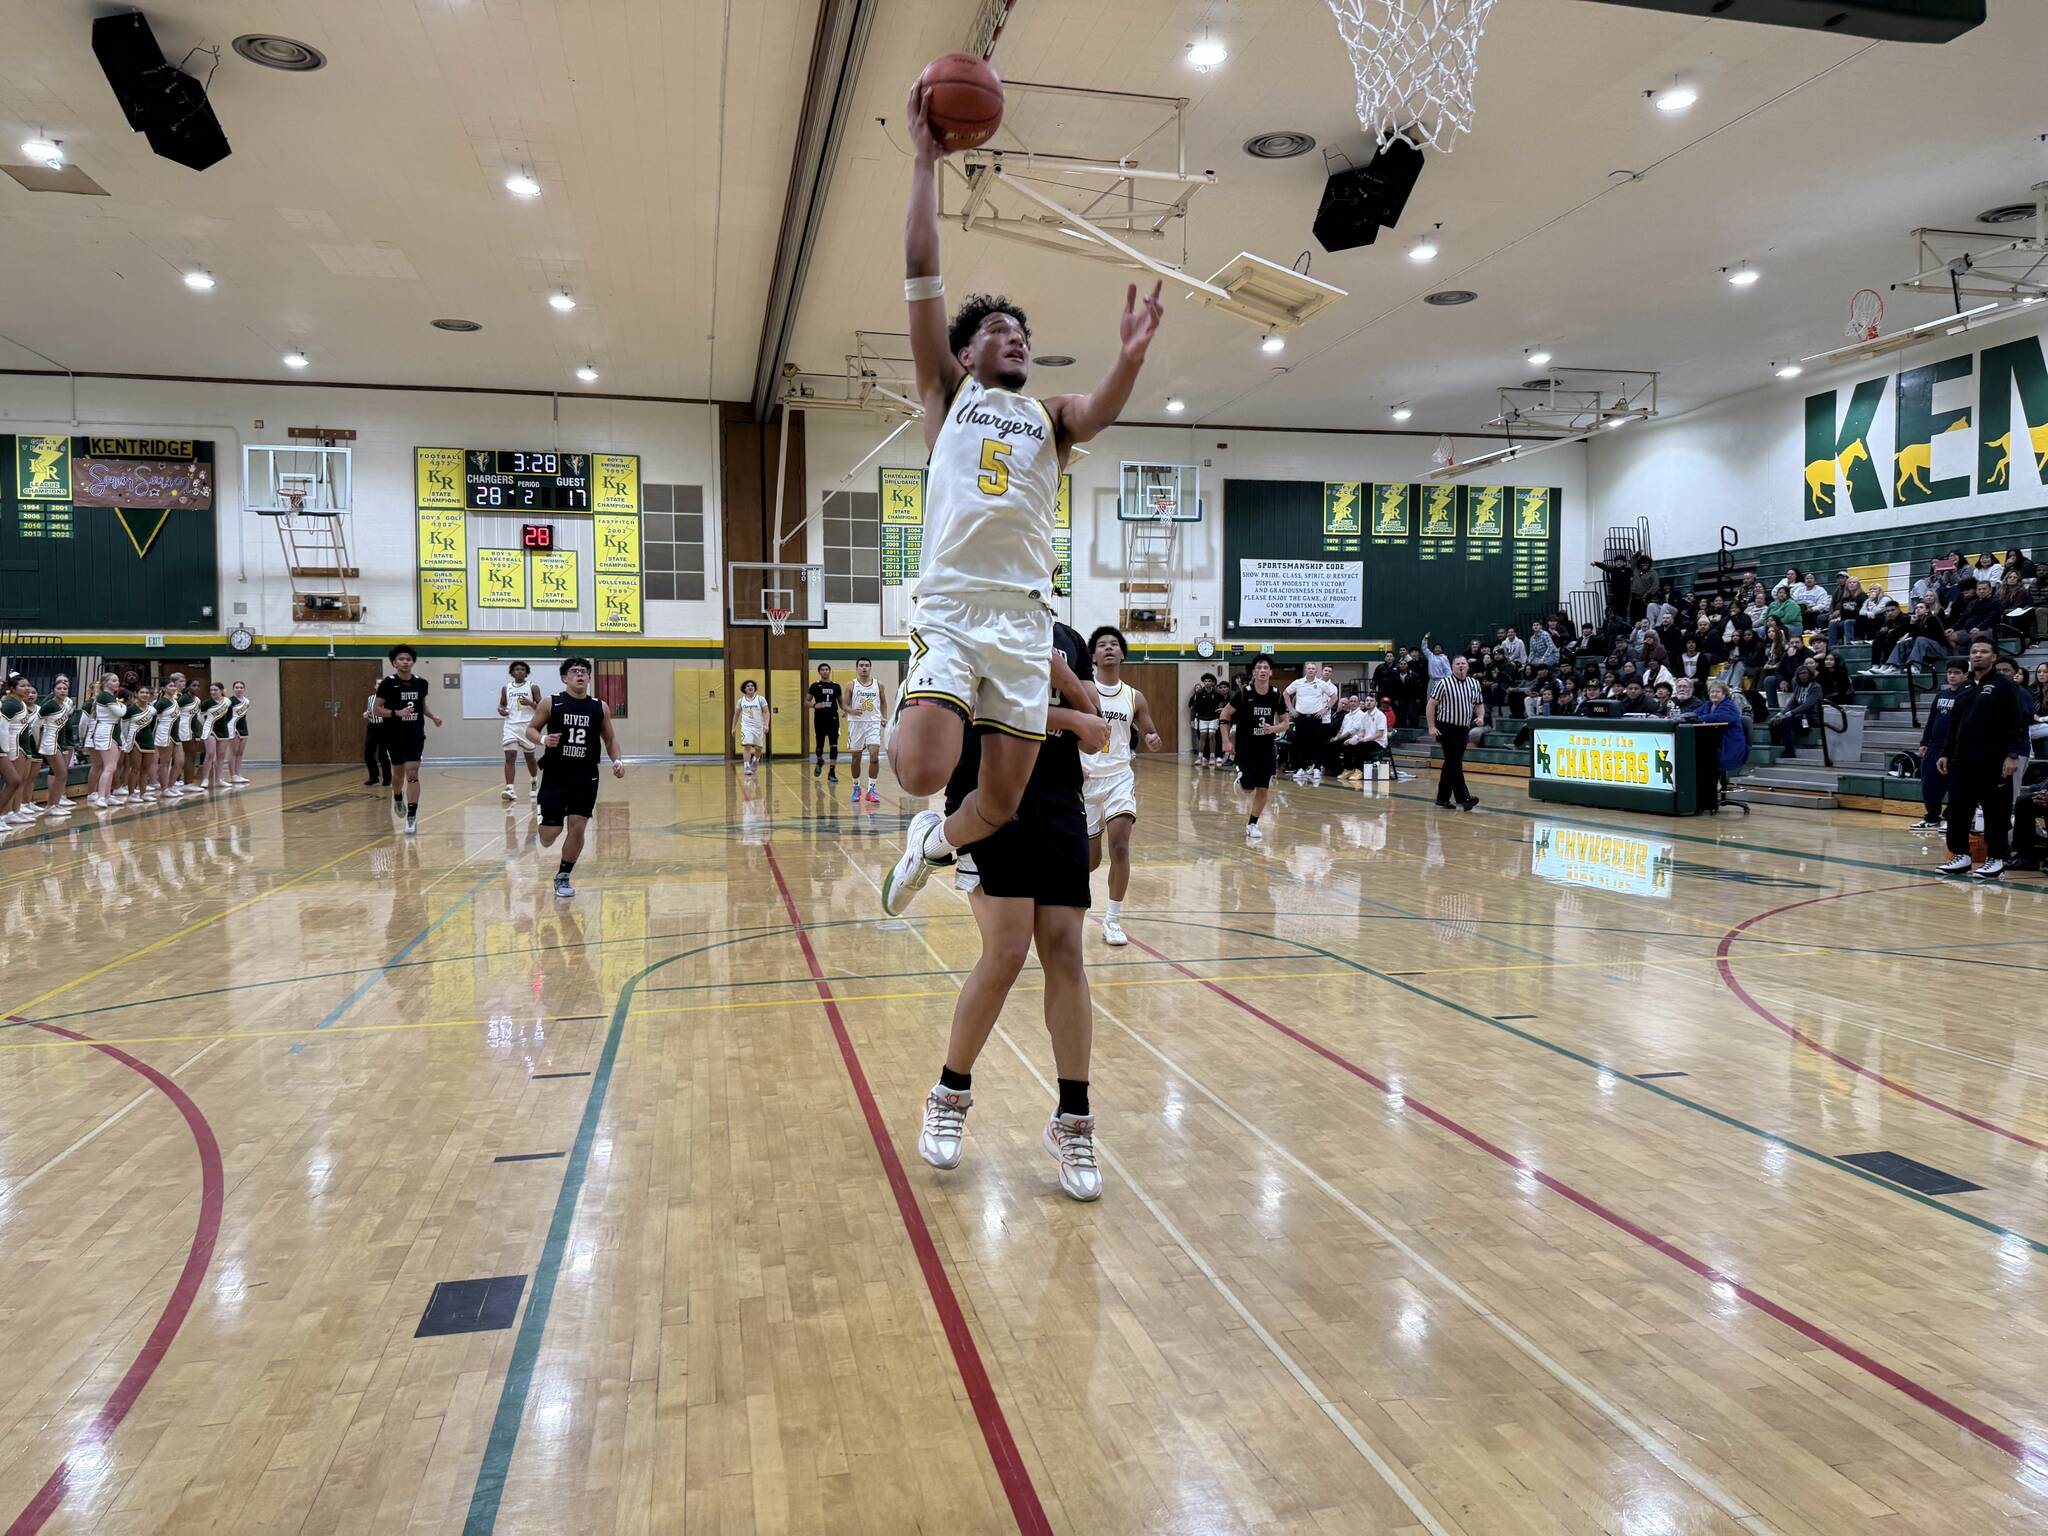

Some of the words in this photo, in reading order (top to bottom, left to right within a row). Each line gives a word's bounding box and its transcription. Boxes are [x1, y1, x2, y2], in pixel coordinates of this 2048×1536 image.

[957, 401, 1044, 440] Chargers
[1805, 335, 2048, 521] KEN
[91, 439, 192, 456] KENTRIDGE
[514, 453, 556, 473] 3:28
[977, 438, 1012, 496] 5
[467, 474, 514, 485] CHARGERS
[518, 480, 540, 488] PERIOD
[556, 476, 585, 487] GUEST
[476, 486, 501, 505] 28
[524, 489, 533, 504] 2
[569, 489, 586, 507] 17
[525, 527, 549, 546] 28
[401, 692, 418, 700] RIVER
[1254, 707, 1271, 715] RIVER
[563, 714, 589, 726] RIVER
[1259, 717, 1265, 727] 3
[568, 728, 586, 744] 12
[1569, 735, 1597, 746] Home
[1602, 736, 1612, 747] of
[1616, 736, 1634, 748] the
[562, 745, 586, 757] RIDGE
[1556, 748, 1649, 784] CHARGERS
